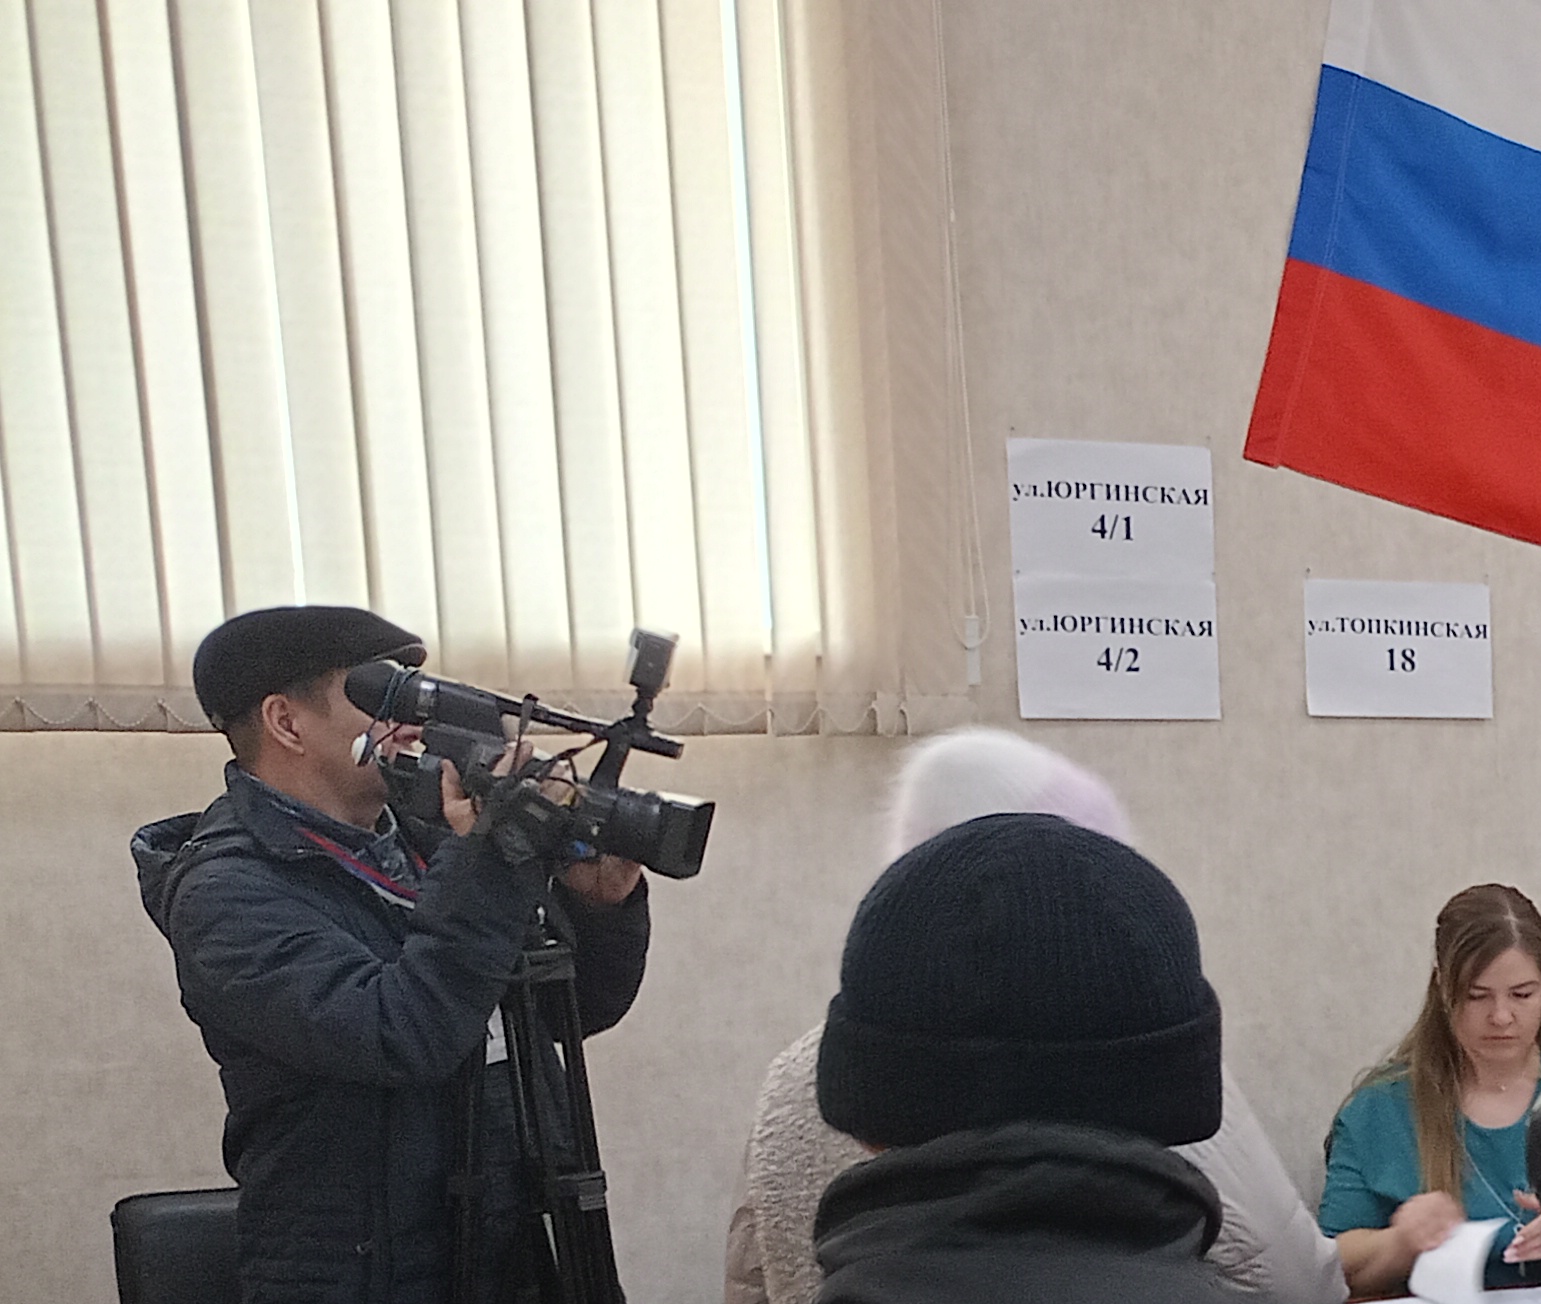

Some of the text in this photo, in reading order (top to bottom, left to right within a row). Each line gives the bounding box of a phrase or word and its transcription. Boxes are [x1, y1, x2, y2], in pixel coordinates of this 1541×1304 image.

[1012, 480, 1209, 506] ул.ЮРГИНСКАЯ
[1090, 513, 1134, 541] 4/1
[1019, 614, 1214, 638] ул.ЮРГИНСКАЯ
[1307, 616, 1488, 639] ул.ТОПКИНСКАЯ
[1096, 646, 1141, 673] 4/2
[1386, 647, 1417, 673] 18
